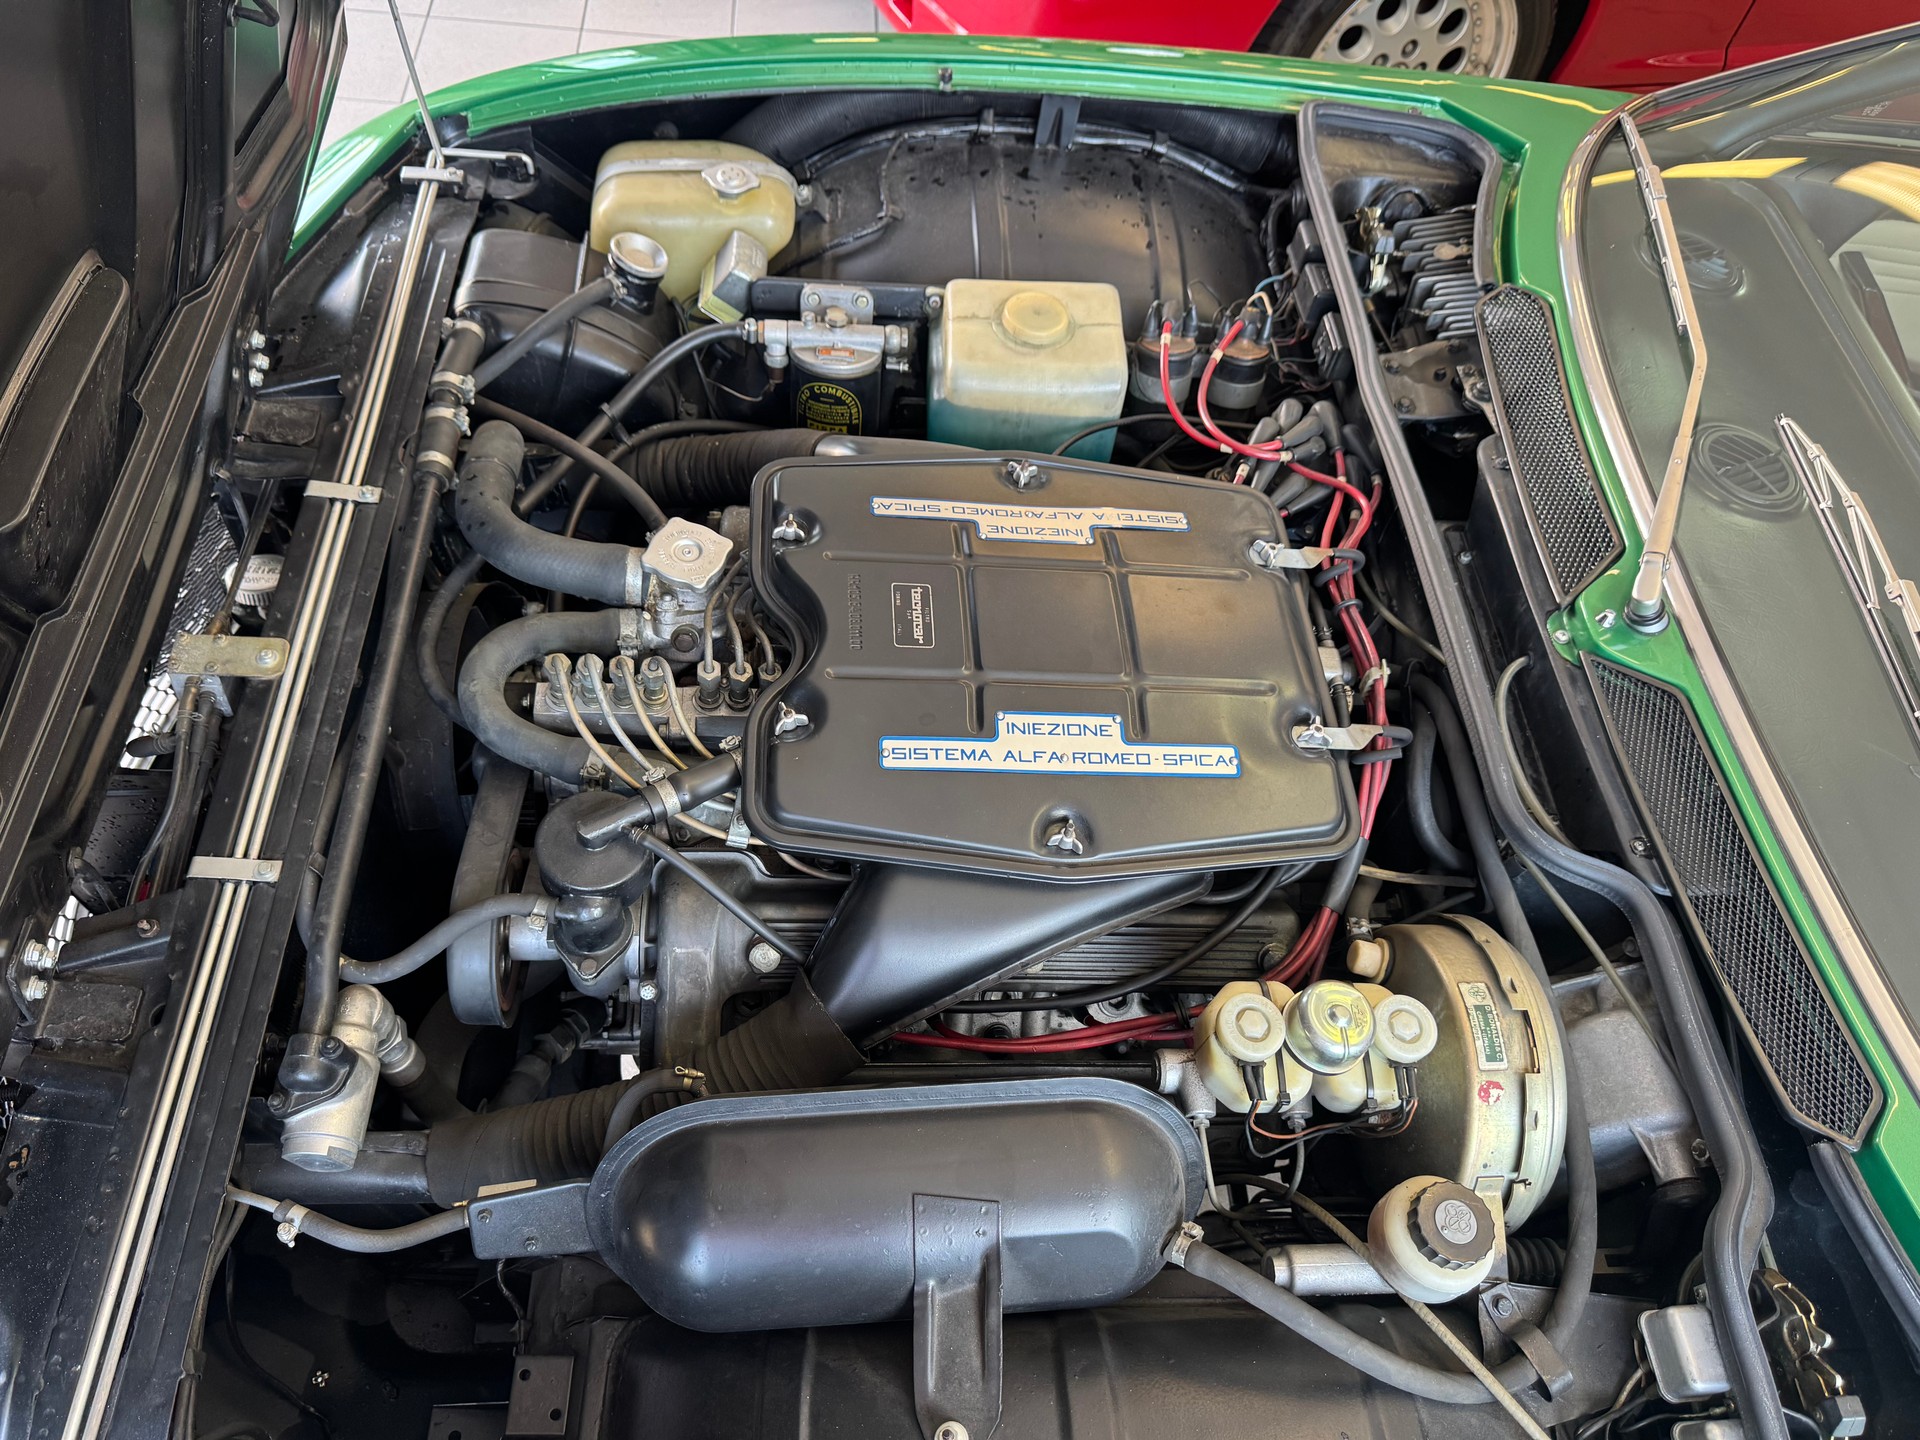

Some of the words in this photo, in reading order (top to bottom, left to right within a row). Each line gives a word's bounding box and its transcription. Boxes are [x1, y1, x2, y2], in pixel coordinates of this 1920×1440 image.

[1033, 511, 1083, 521] ALFA
[987, 525, 1084, 538] INIEZIONE
[911, 586, 924, 644] tecnocar
[1006, 722, 1113, 738] INIEZIONE
[891, 747, 992, 762] SISTEMA
[1003, 749, 1062, 764] ALFA
[1487, 1013, 1500, 1046] BONALDI
